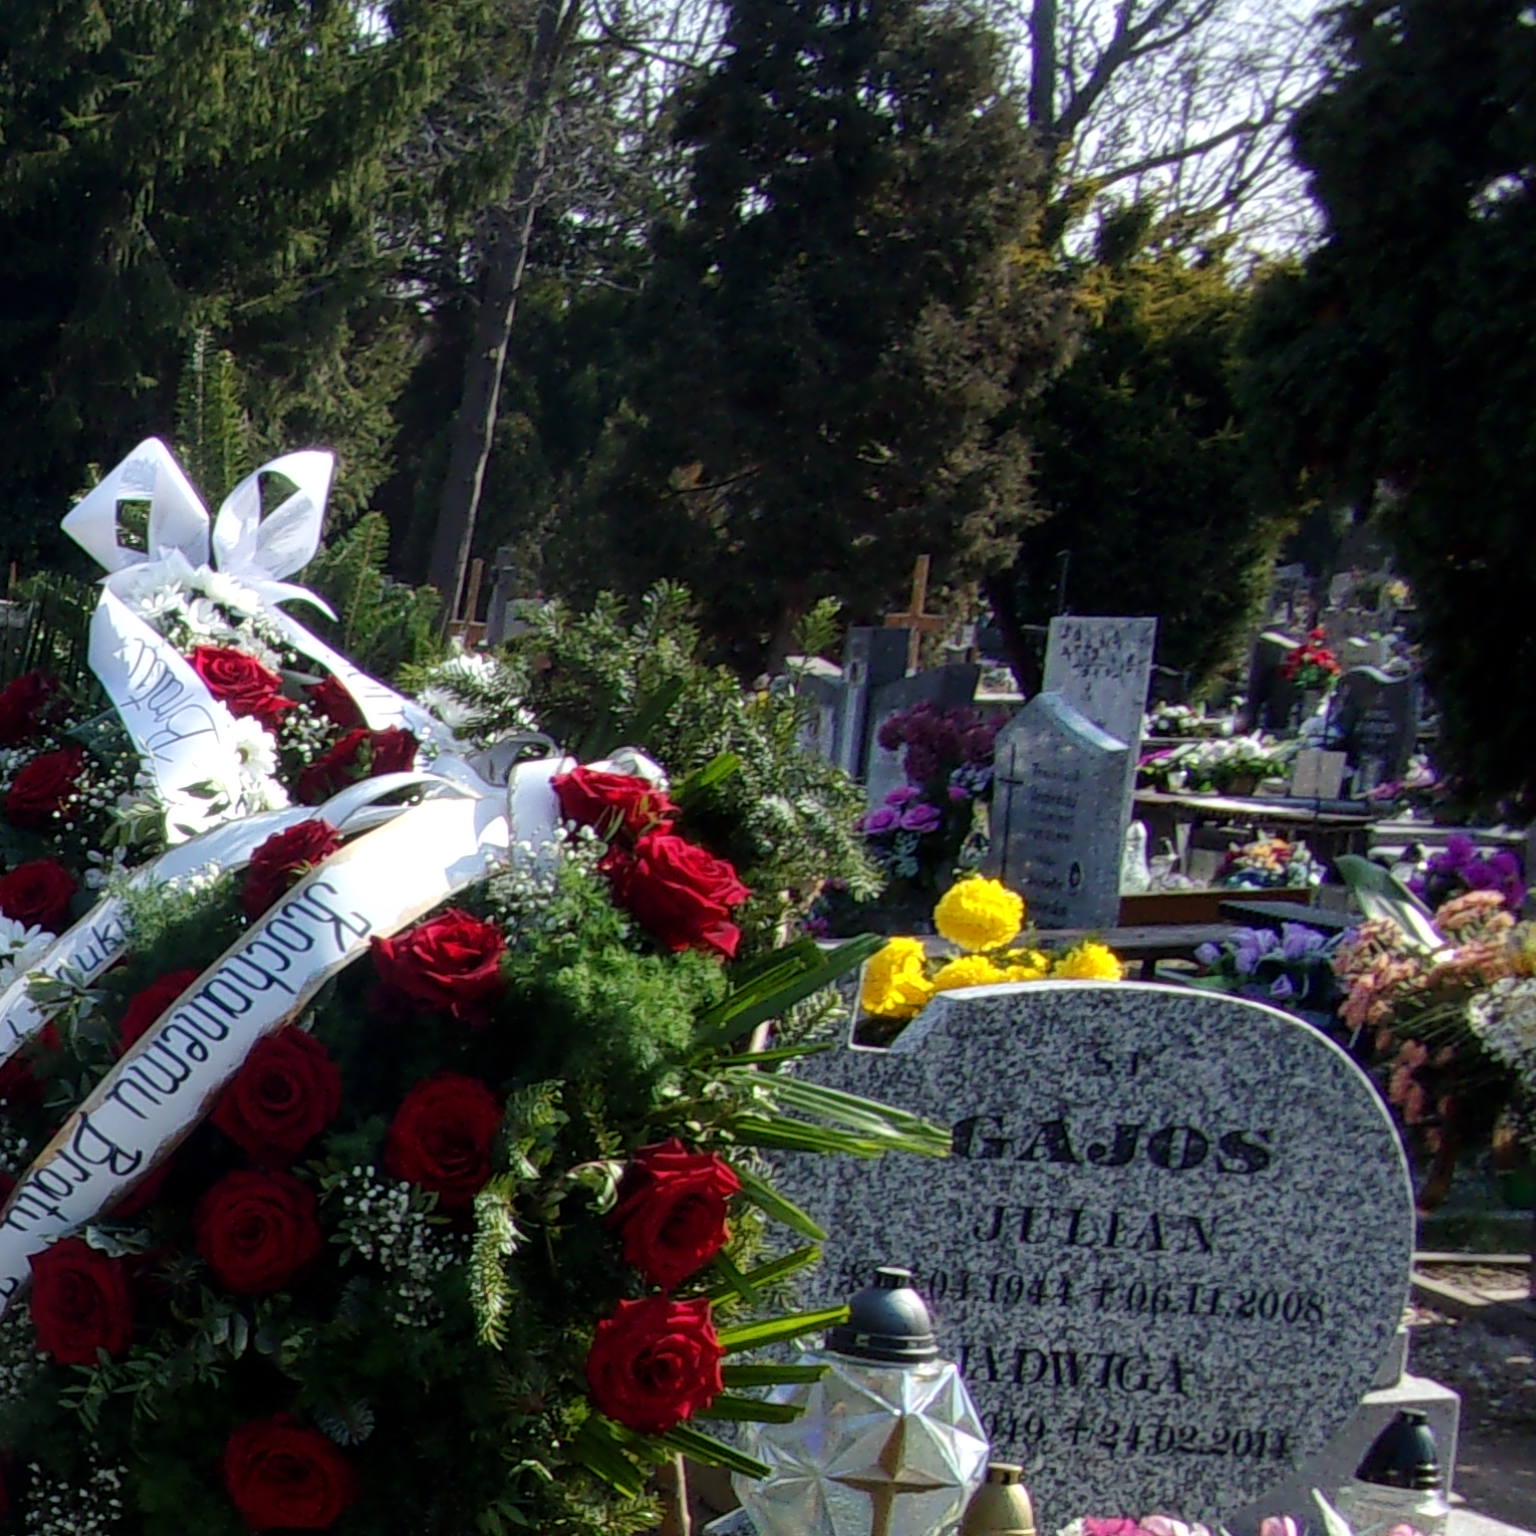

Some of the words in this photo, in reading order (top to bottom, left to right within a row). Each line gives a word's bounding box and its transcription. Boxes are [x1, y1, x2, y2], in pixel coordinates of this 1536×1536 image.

[104, 881, 373, 1121] Kochanemu
[3, 1110, 143, 1232] Bratu
[951, 1114, 1276, 1175] GAJOS
[972, 1204, 1218, 1255] JULIAN
